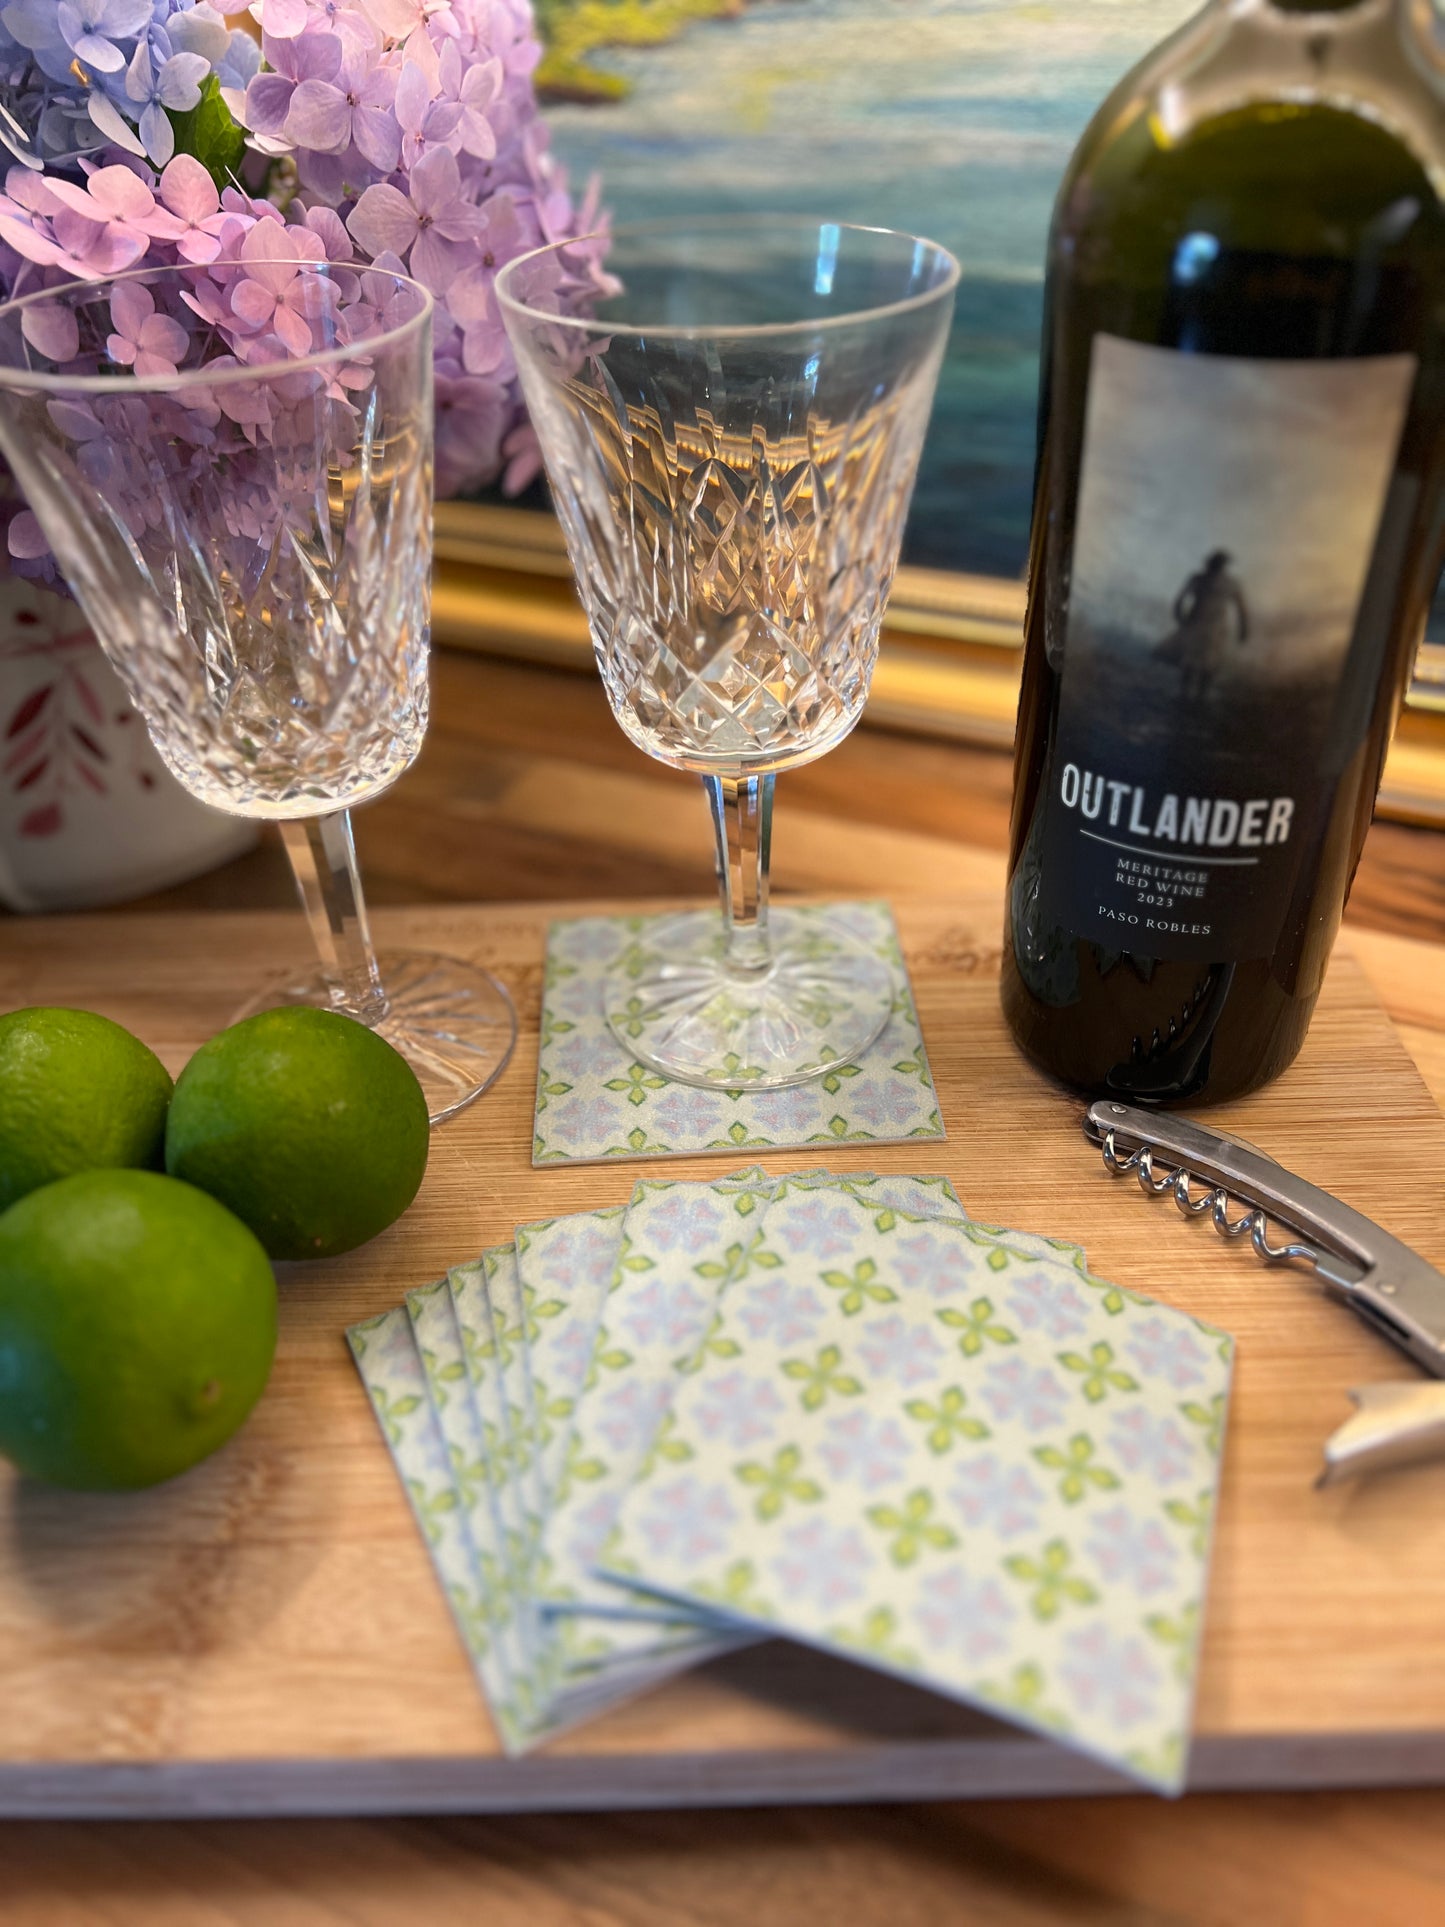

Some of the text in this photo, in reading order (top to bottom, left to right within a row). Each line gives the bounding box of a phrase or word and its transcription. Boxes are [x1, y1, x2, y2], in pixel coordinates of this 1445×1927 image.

[1061, 763, 1295, 847] OUTLANDER
[1117, 858, 1208, 883] MERITAGE
[1116, 872, 1205, 898] RED WINE
[1137, 892, 1174, 908] 2023
[1098, 906, 1211, 935] PASO ROBLES
